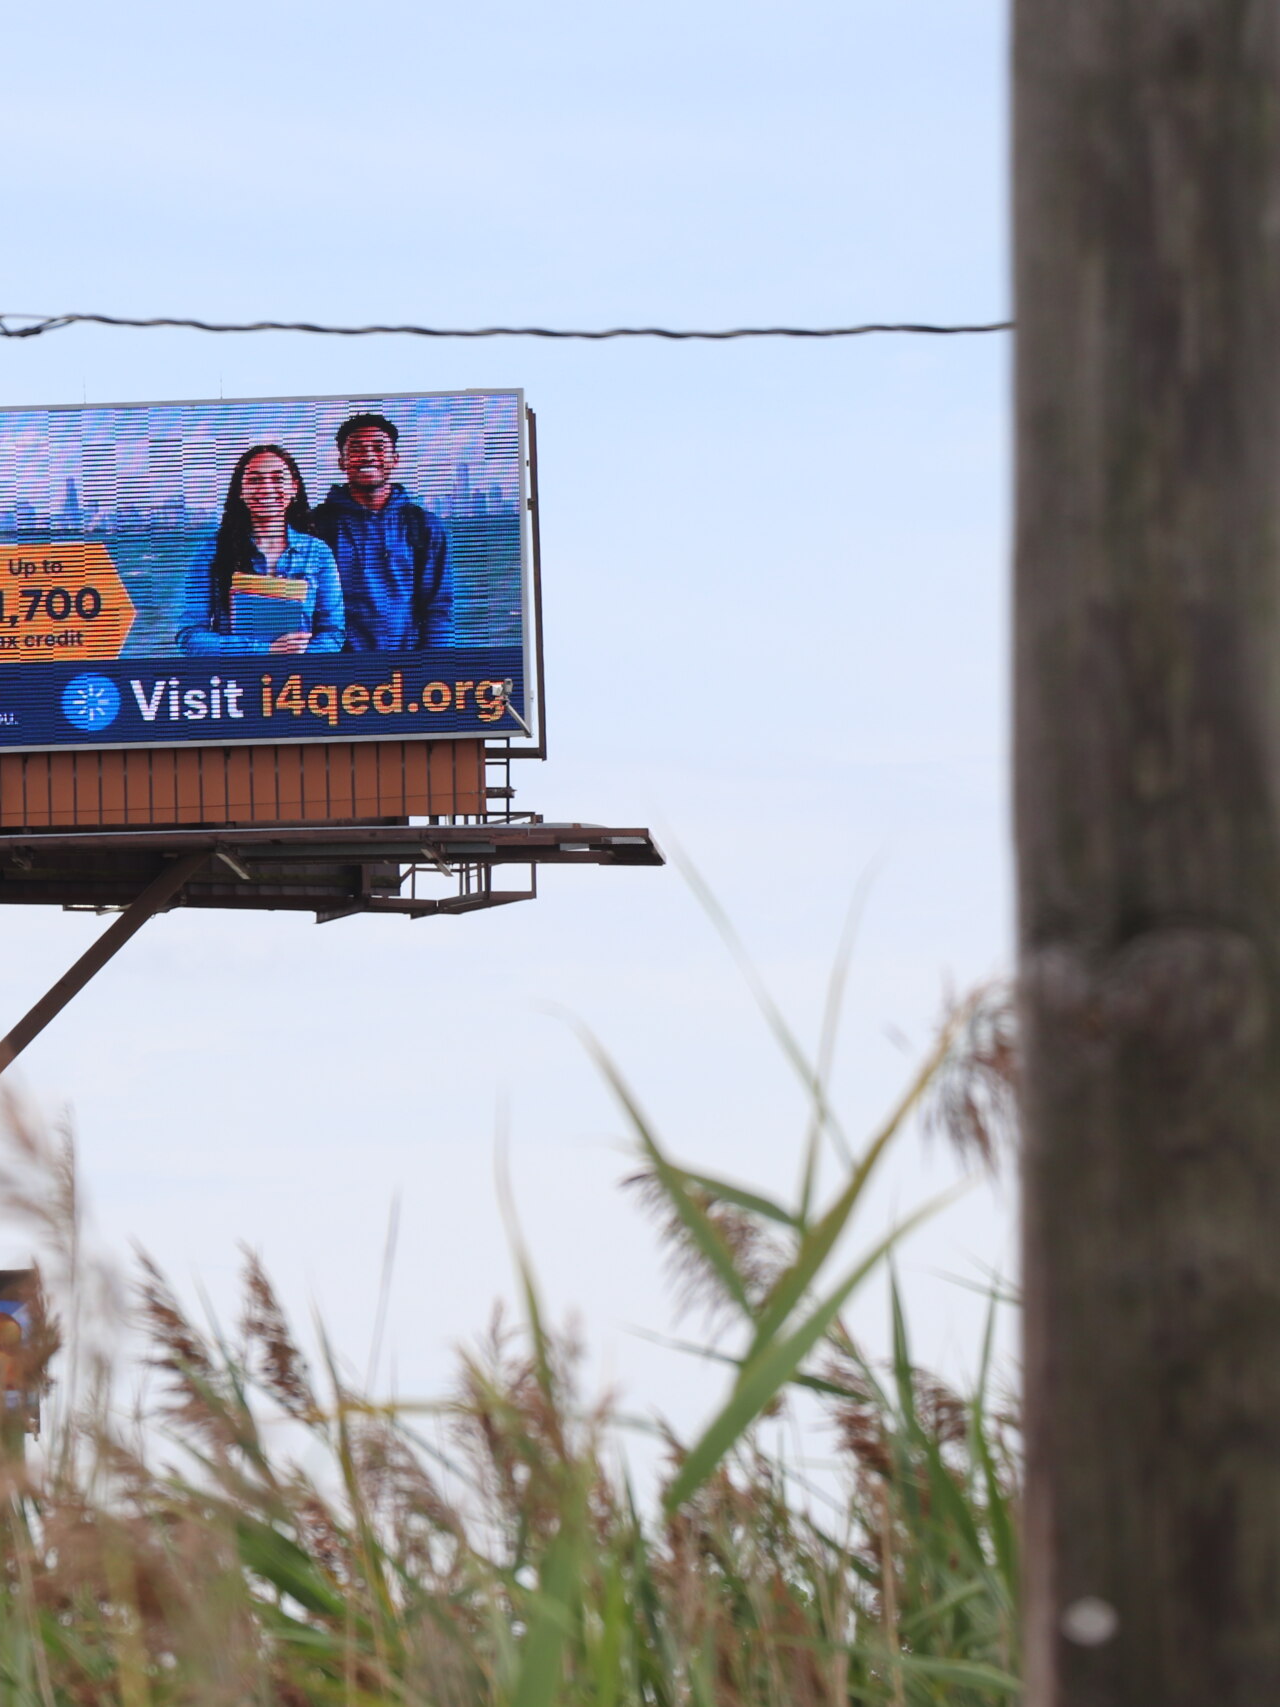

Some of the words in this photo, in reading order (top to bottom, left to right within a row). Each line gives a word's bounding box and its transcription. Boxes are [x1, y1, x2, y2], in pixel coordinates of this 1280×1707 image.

[8, 559, 36, 578] Up
[42, 559, 64, 574] to
[24, 631, 84, 648] credit
[130, 675, 245, 721] Visit
[261, 671, 508, 726] i4qed.org
